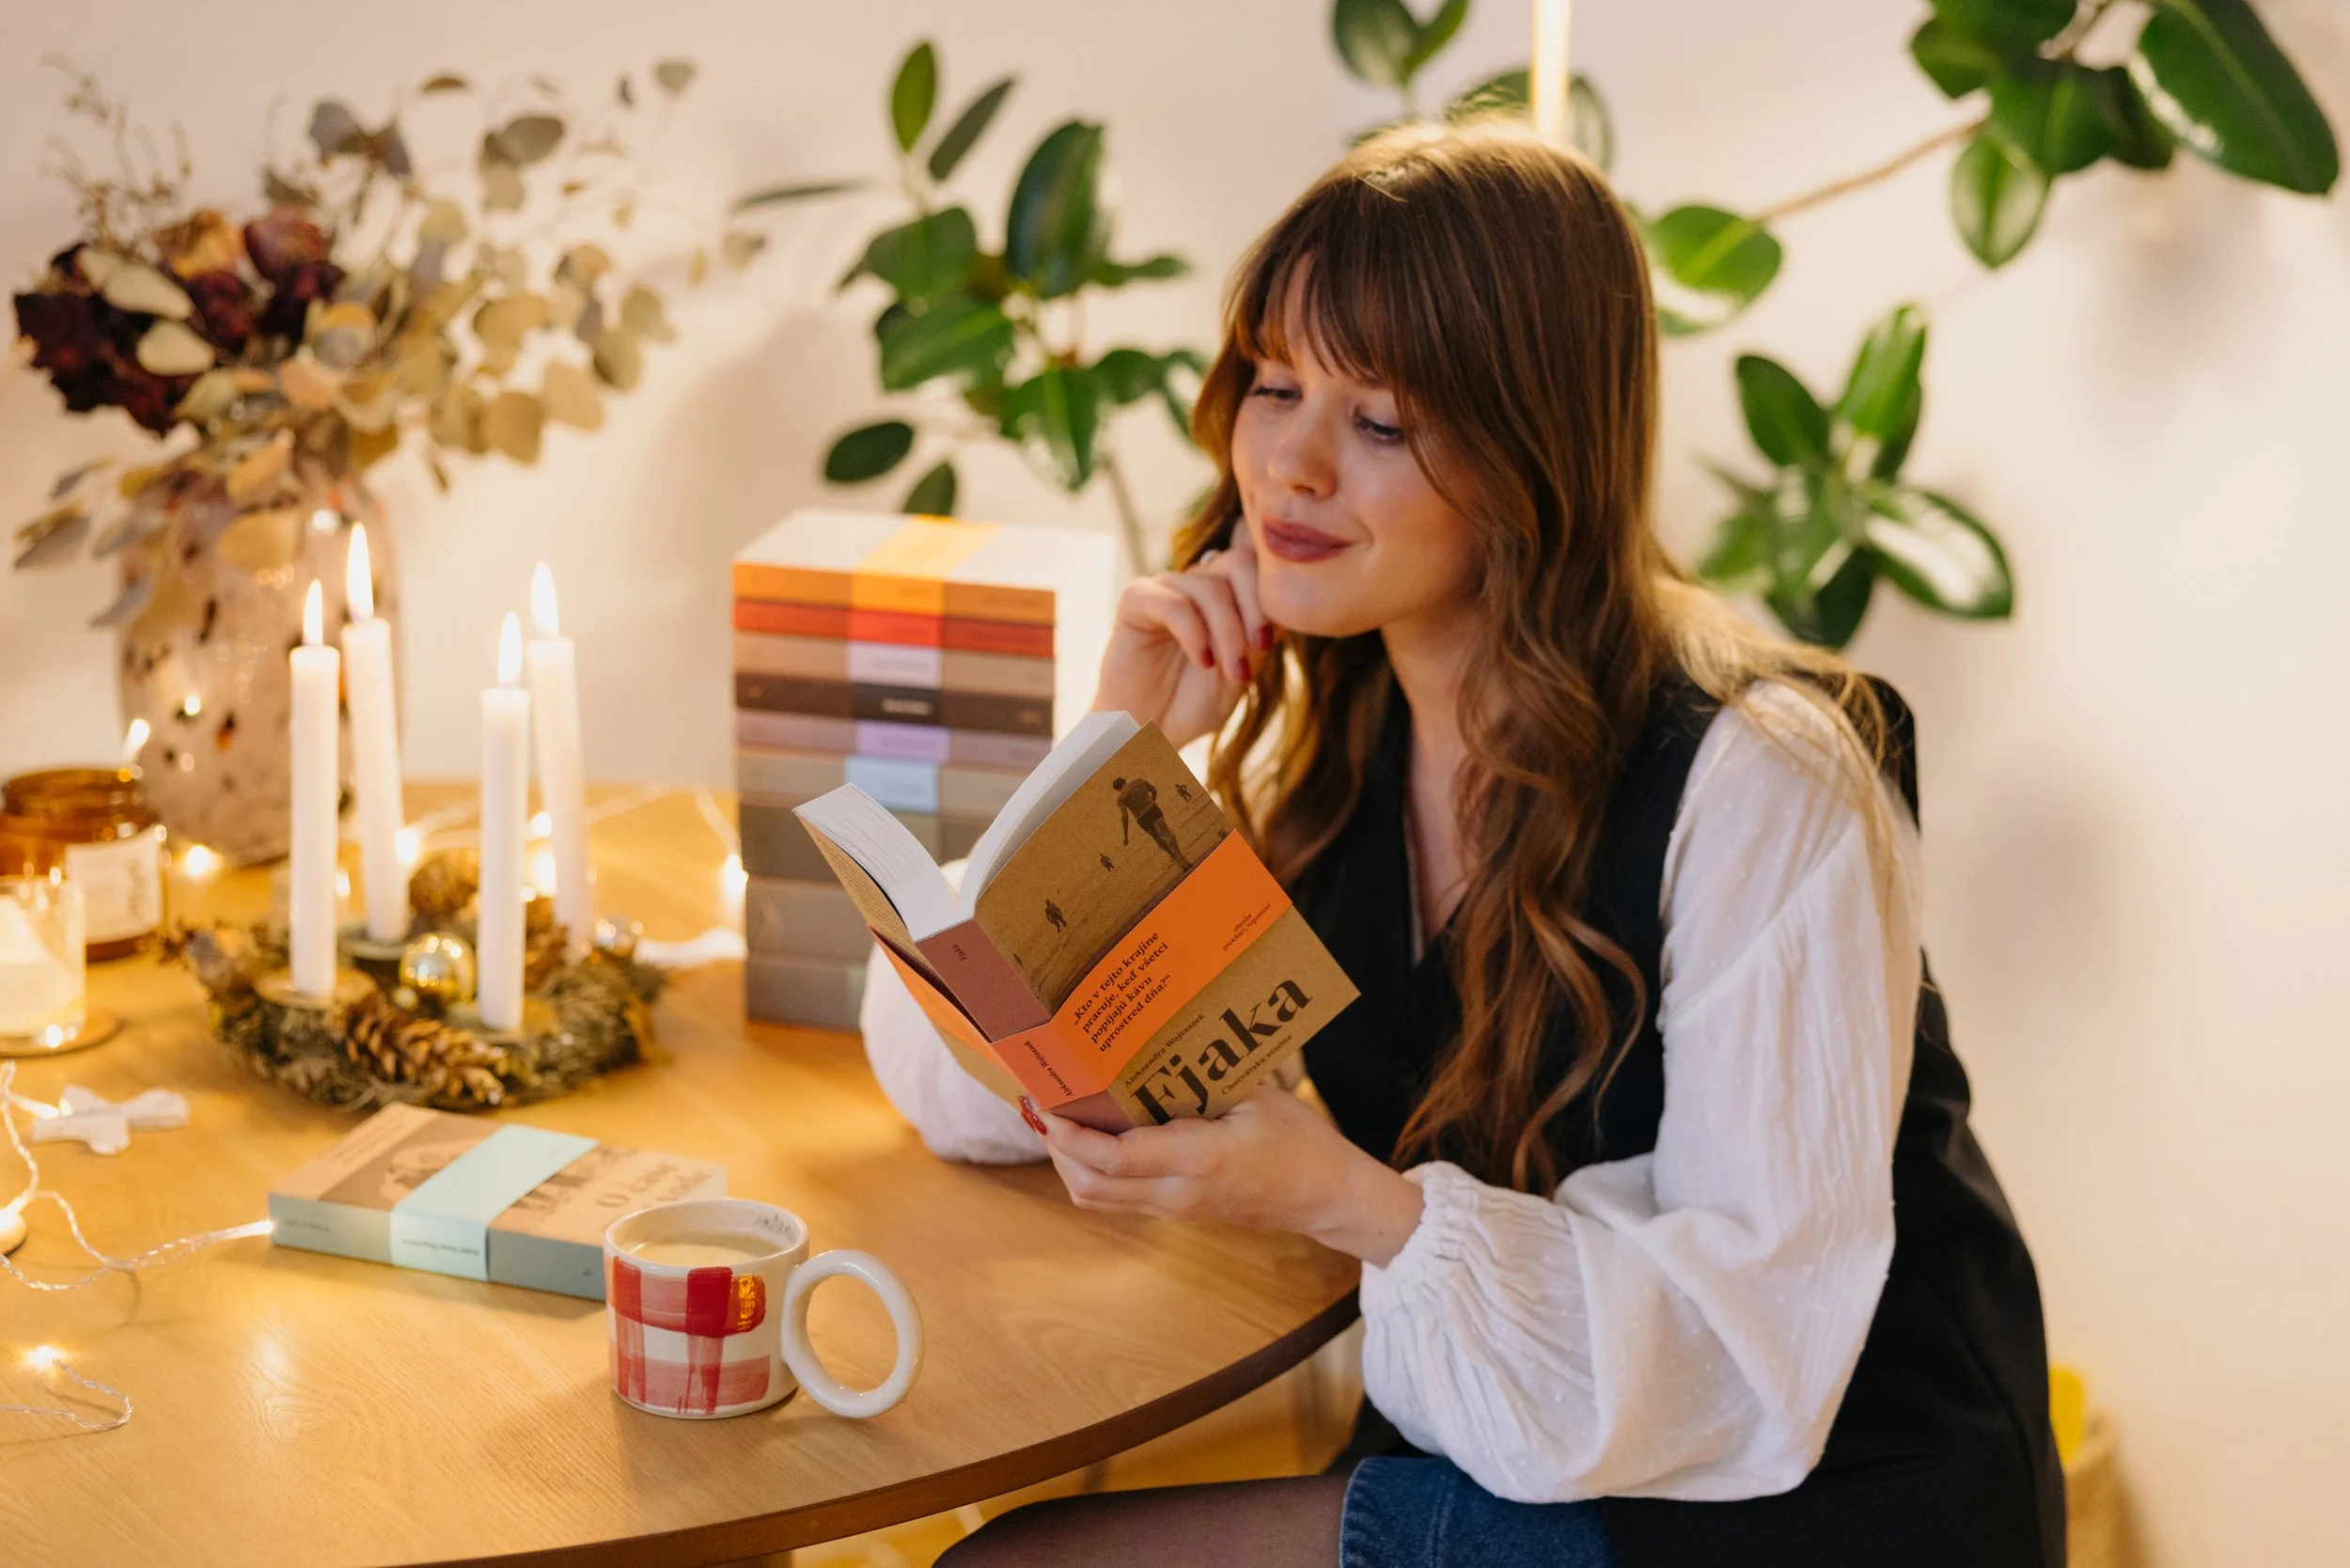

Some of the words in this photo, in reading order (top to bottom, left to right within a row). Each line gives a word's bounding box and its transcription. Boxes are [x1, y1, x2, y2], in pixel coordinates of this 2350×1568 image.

[1083, 993, 1120, 1033] pracuje,
[1117, 969, 1137, 992] keď
[1138, 942, 1168, 972] všetci
[1100, 967, 1123, 991] tejto
[1122, 933, 1159, 968] krajine
[1126, 977, 1152, 1002] kávu
[1024, 1041, 1048, 1069] Wojtaszek
[1100, 1002, 1144, 1052] uprostred
[1125, 1047, 1167, 1088] Aleksandra
[1166, 1012, 1205, 1048] Wojtaszek
[1130, 980, 1313, 1125] Fjaka
[1047, 1066, 1073, 1096] Aleksandra
[1221, 1057, 1266, 1095] Chorvátska
[1266, 1034, 1292, 1058] sezóna
